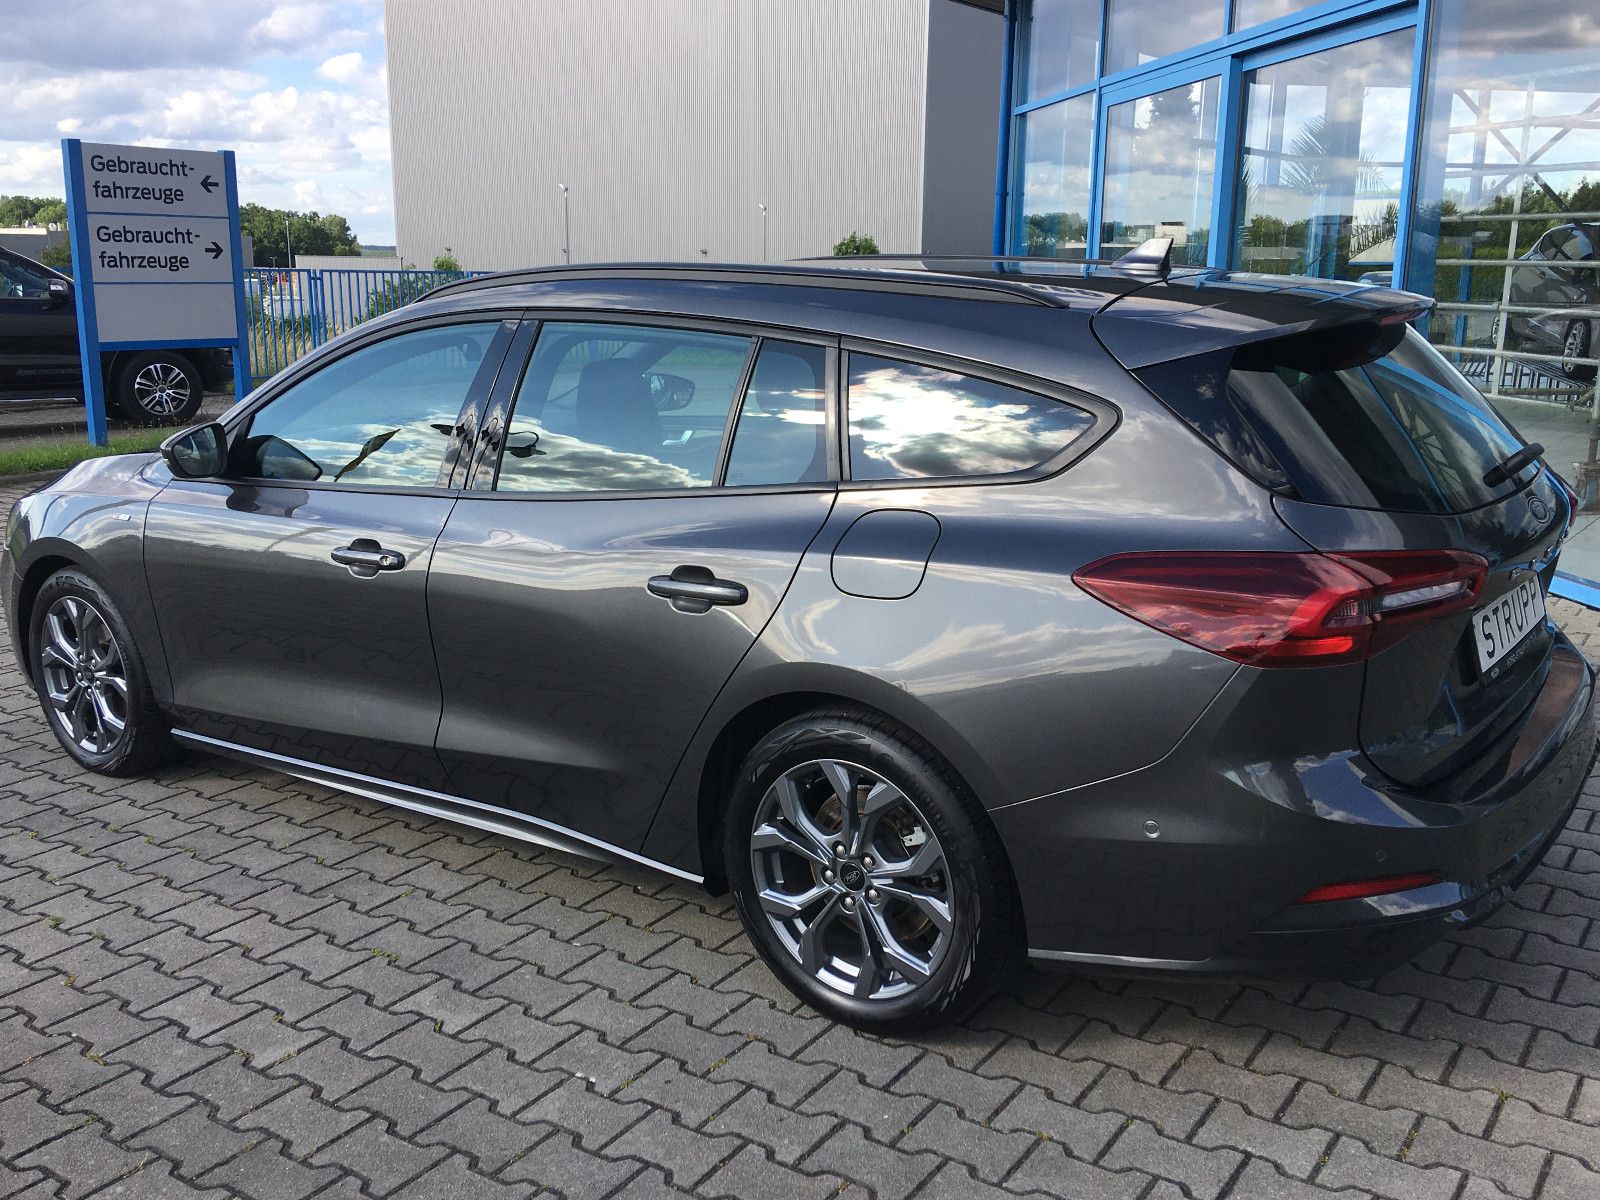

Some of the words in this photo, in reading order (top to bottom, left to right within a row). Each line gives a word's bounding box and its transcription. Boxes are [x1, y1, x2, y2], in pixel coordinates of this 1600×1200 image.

[90, 154, 195, 177] Gebraucht-
[92, 180, 185, 205] fahrzeuge
[96, 225, 201, 244] Gebraucht-
[98, 250, 190, 272] fahrzeuge
[1481, 580, 1537, 660] STRUPP
